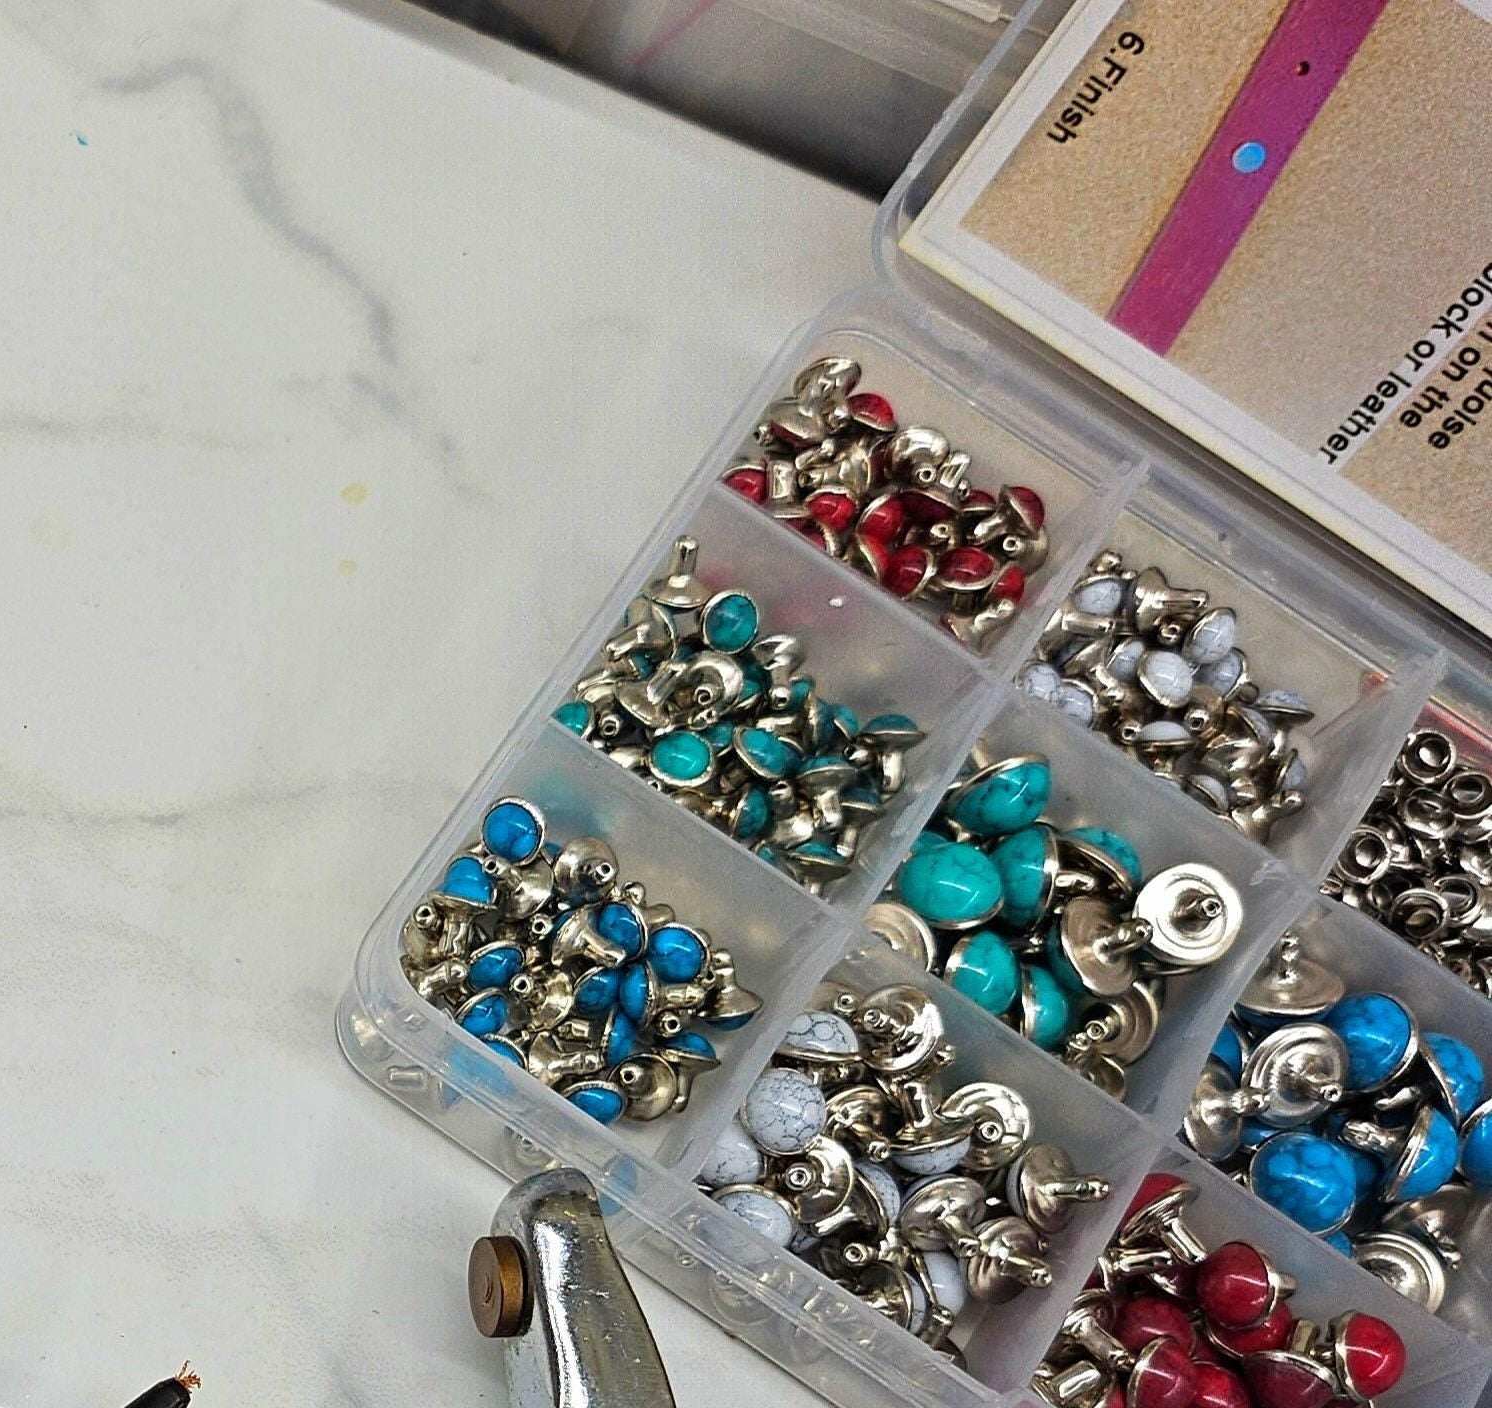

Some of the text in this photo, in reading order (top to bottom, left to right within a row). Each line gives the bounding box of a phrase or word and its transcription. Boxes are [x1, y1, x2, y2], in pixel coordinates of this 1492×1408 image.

[1046, 30, 1146, 145] 6.Finish
[1399, 346, 1481, 428] on the
[1405, 339, 1435, 372] or
[1319, 371, 1412, 465] leather
[1427, 366, 1492, 450] uoise
